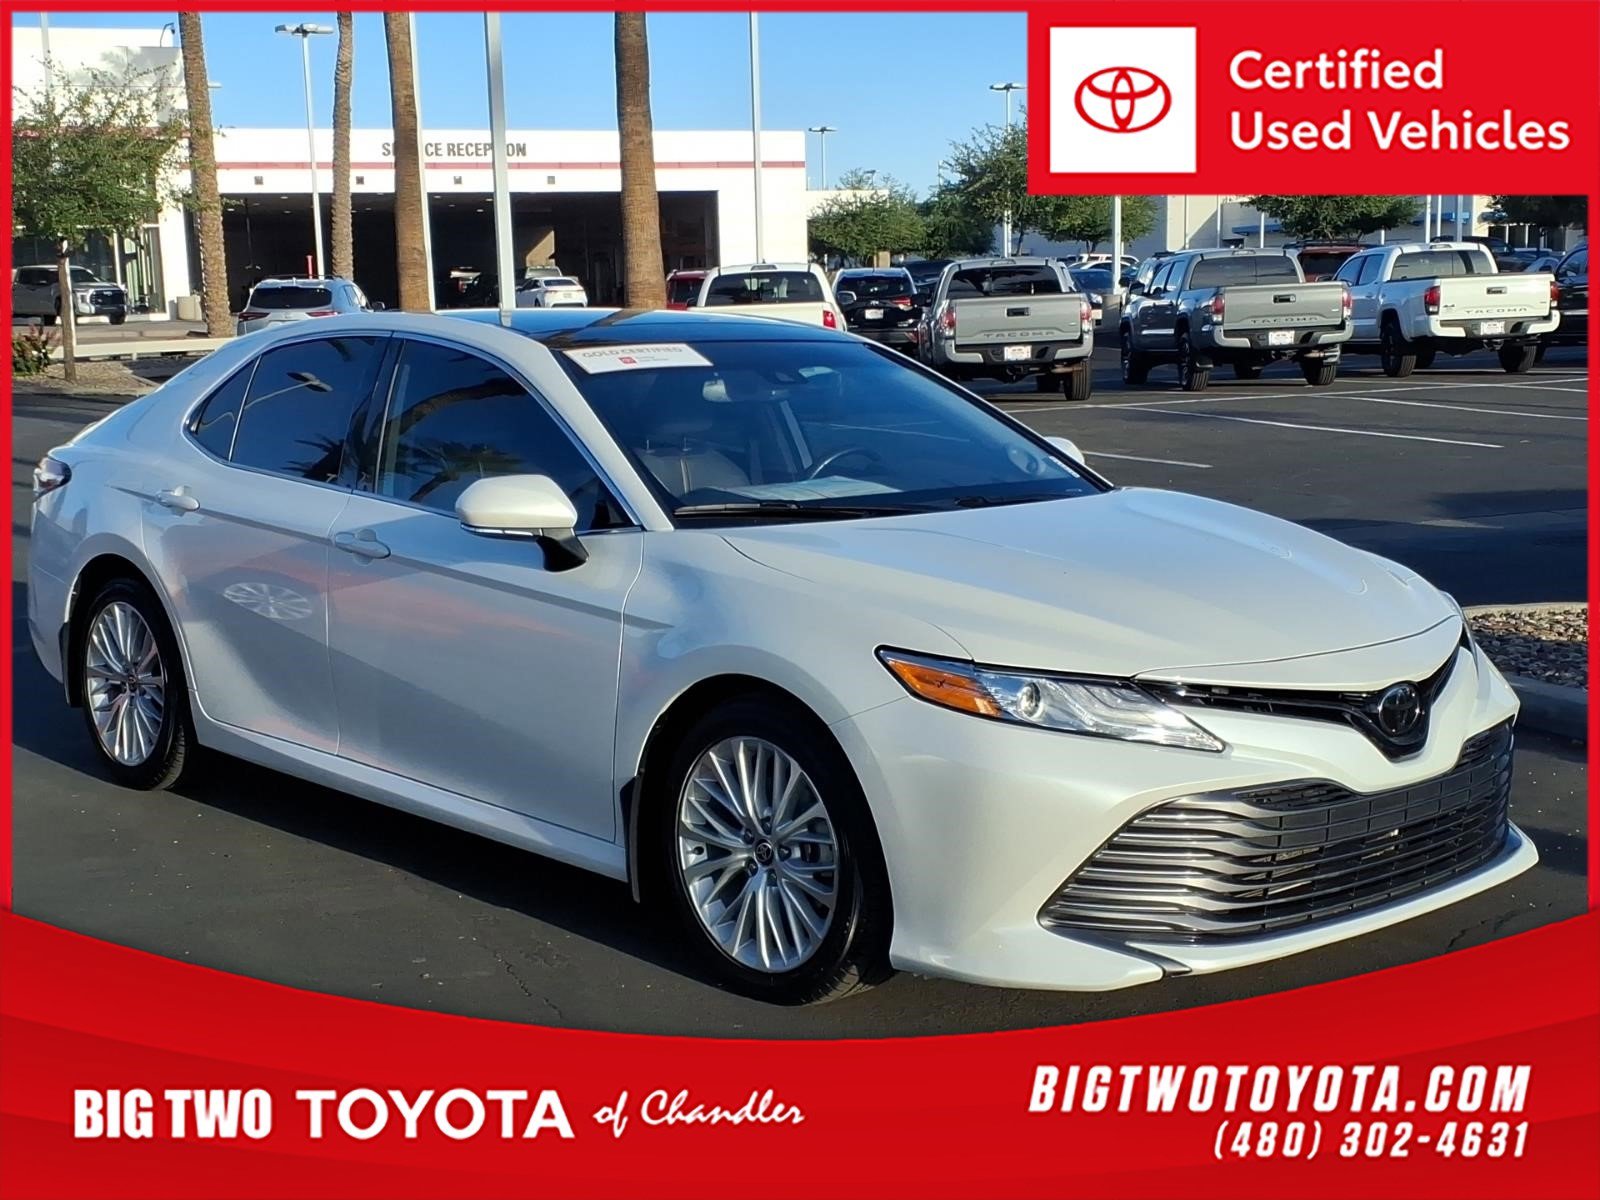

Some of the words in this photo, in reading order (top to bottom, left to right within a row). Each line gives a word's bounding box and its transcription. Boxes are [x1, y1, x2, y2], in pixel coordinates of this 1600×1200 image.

[447, 142, 527, 157] RECEPON
[583, 350, 620, 358] GOLD
[622, 347, 683, 355] CERTIFIED
